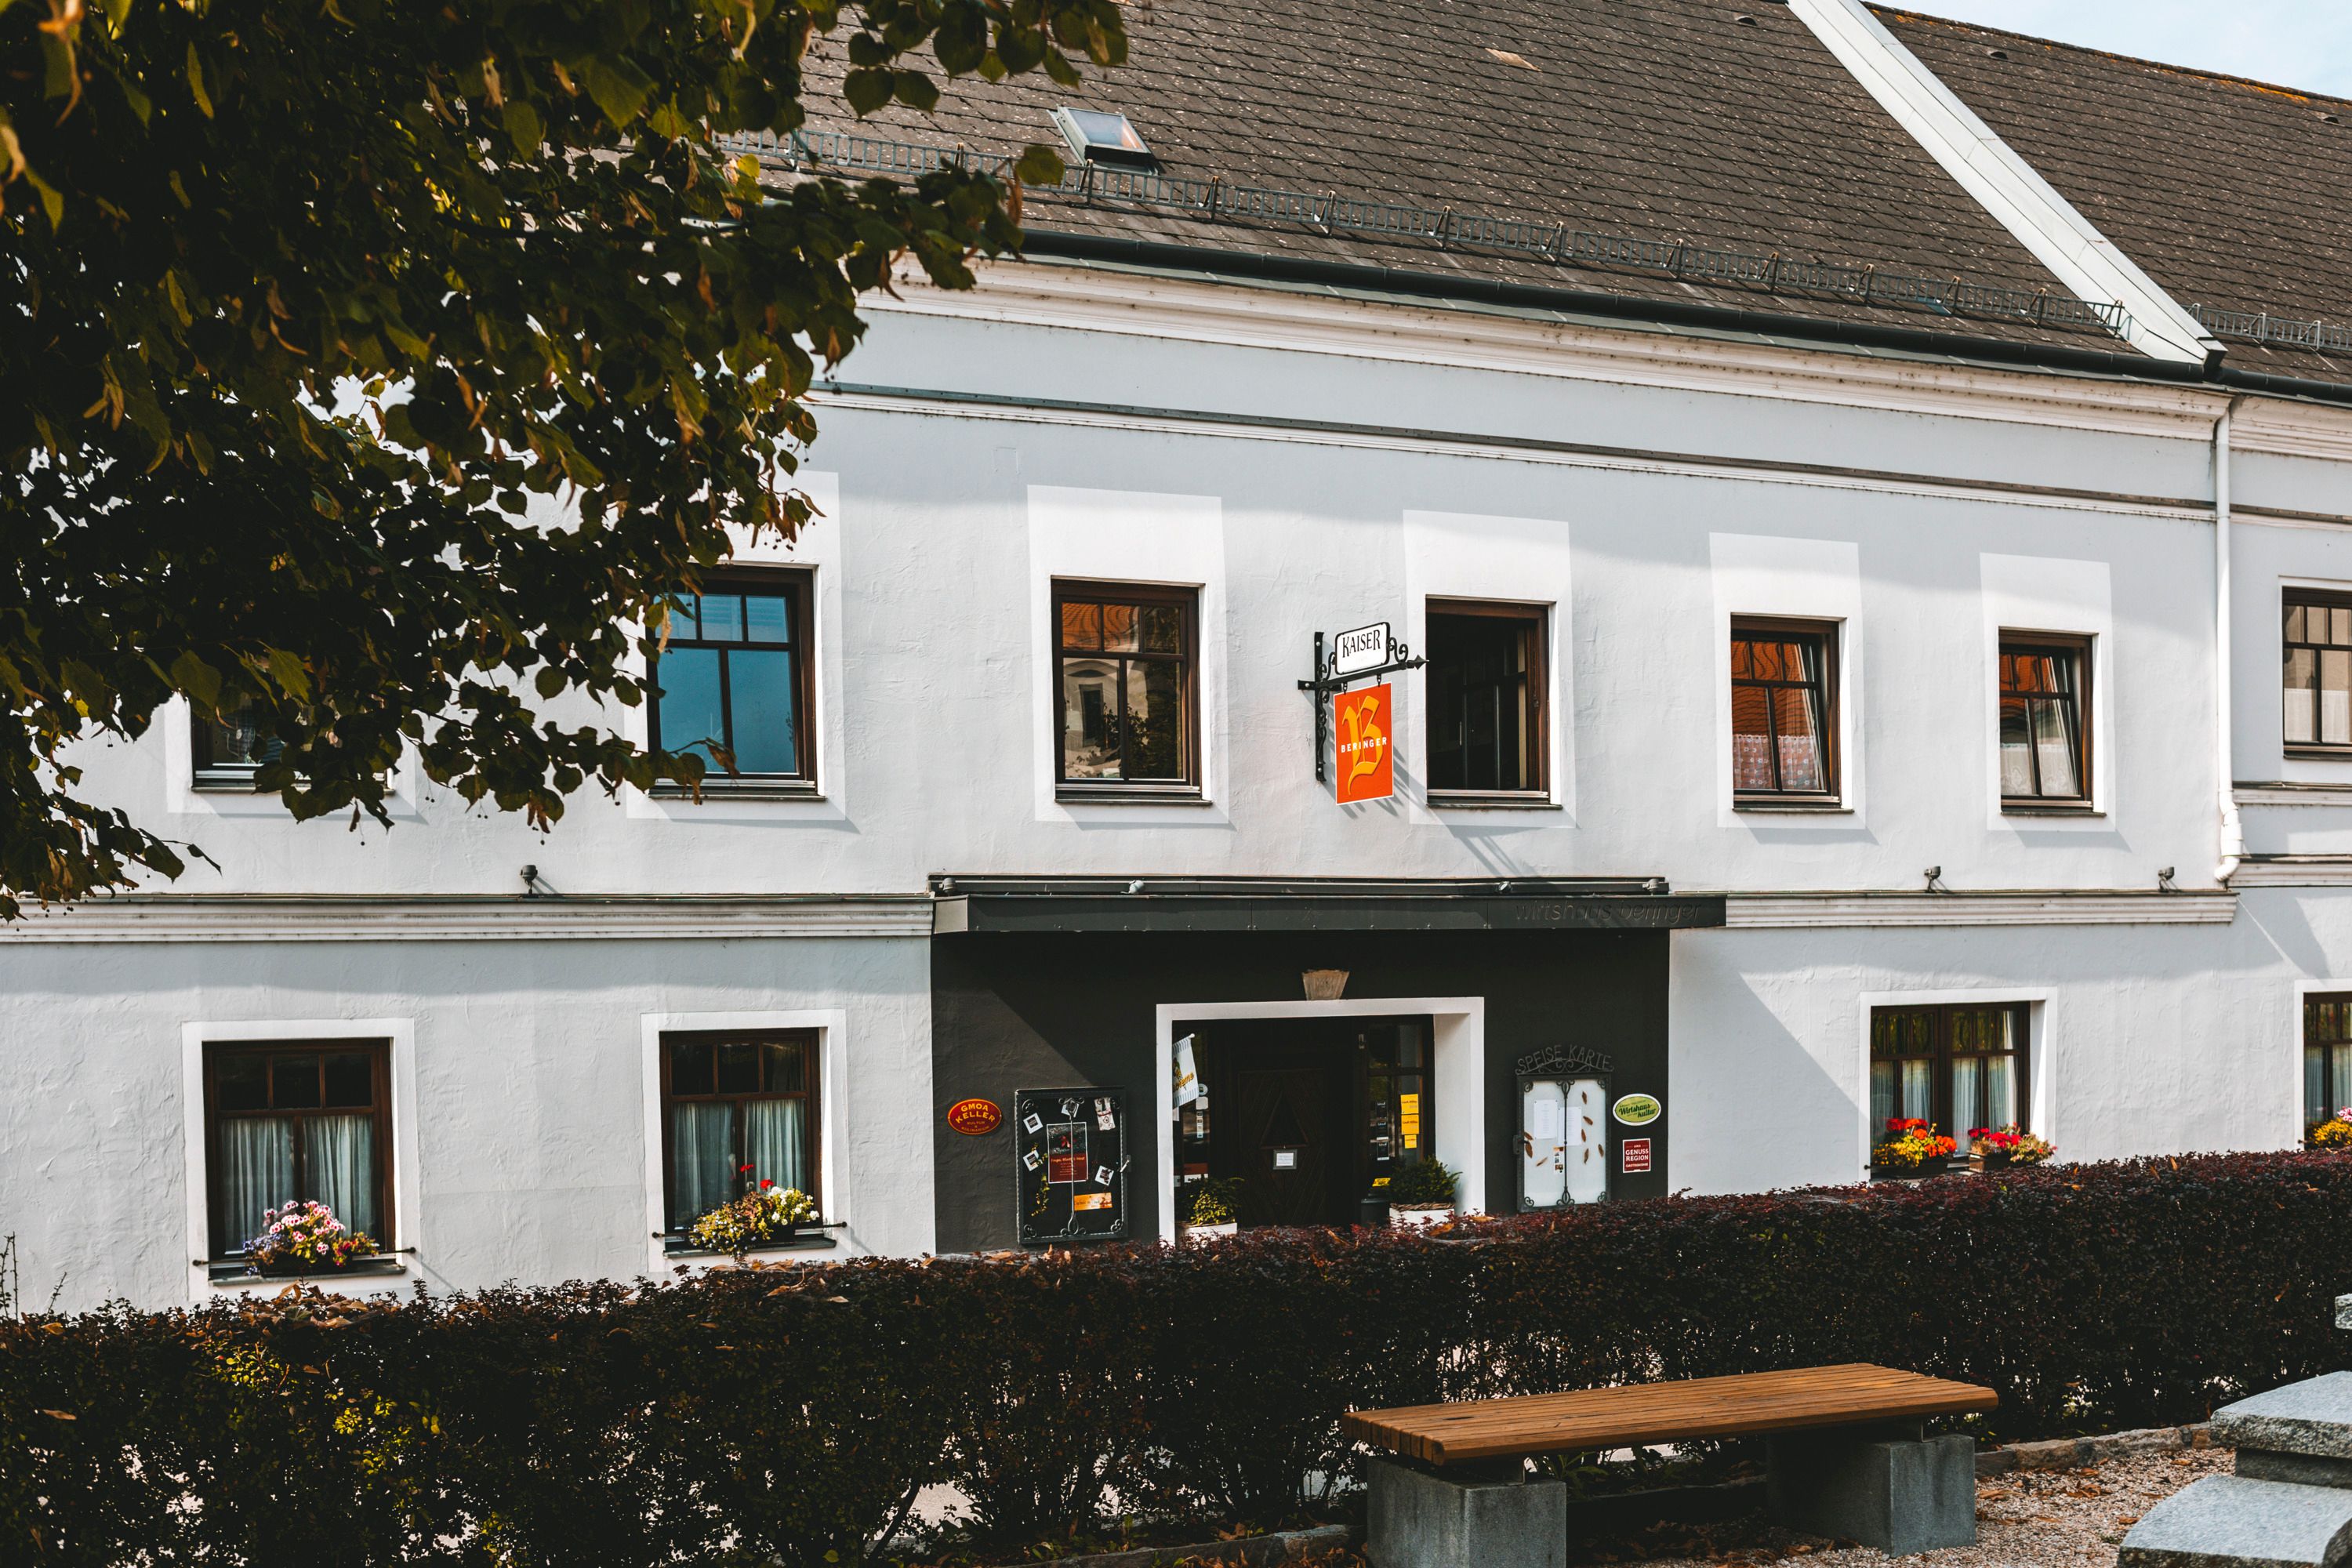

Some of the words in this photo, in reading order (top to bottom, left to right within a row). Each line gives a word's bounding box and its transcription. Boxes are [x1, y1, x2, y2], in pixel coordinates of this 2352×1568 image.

[1342, 629, 1381, 659] KAISER
[1341, 736, 1388, 753] BERINGER
[1515, 901, 1612, 920] wirtshaus
[1619, 901, 1701, 924] beringer
[1517, 1044, 1563, 1072] SPEISE
[1569, 1044, 1613, 1071] KARTE
[960, 1103, 989, 1112] GMOA
[1637, 1108, 1657, 1118] kultur
[955, 1110, 996, 1123] KELLER
